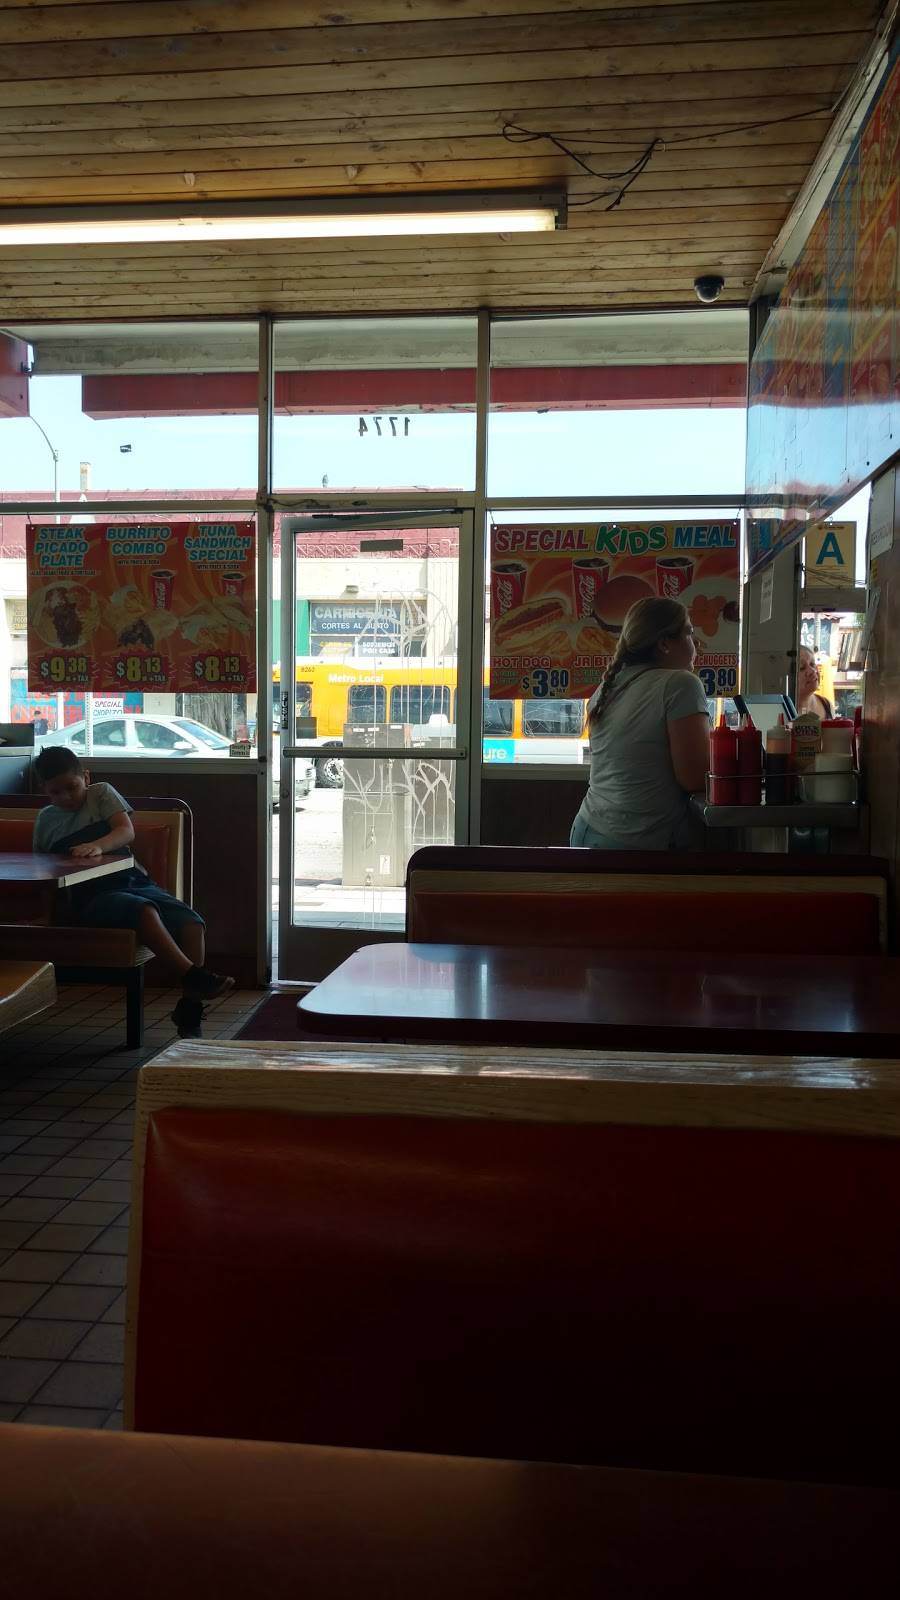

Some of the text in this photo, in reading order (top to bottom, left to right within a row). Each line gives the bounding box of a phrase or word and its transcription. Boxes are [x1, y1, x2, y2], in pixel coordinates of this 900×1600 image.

[40, 527, 84, 540] STEAK
[106, 526, 171, 540] BURRITO
[199, 525, 237, 537] TUNA
[184, 537, 251, 549] SANDWICH
[496, 524, 736, 555] SPECIAL KIDS MEAL
[34, 541, 89, 554] PICADO
[111, 541, 167, 555] COMBO
[815, 531, 845, 565] A
[40, 554, 84, 567] PLATE
[189, 549, 247, 561] SPECIAL
[321, 622, 350, 630] CORTES
[353, 622, 362, 630] AL
[491, 656, 551, 669] HOT DOG
[574, 655, 592, 668] JR
[328, 673, 385, 683] Metro Local
[94, 700, 122, 708] SPECIAL
